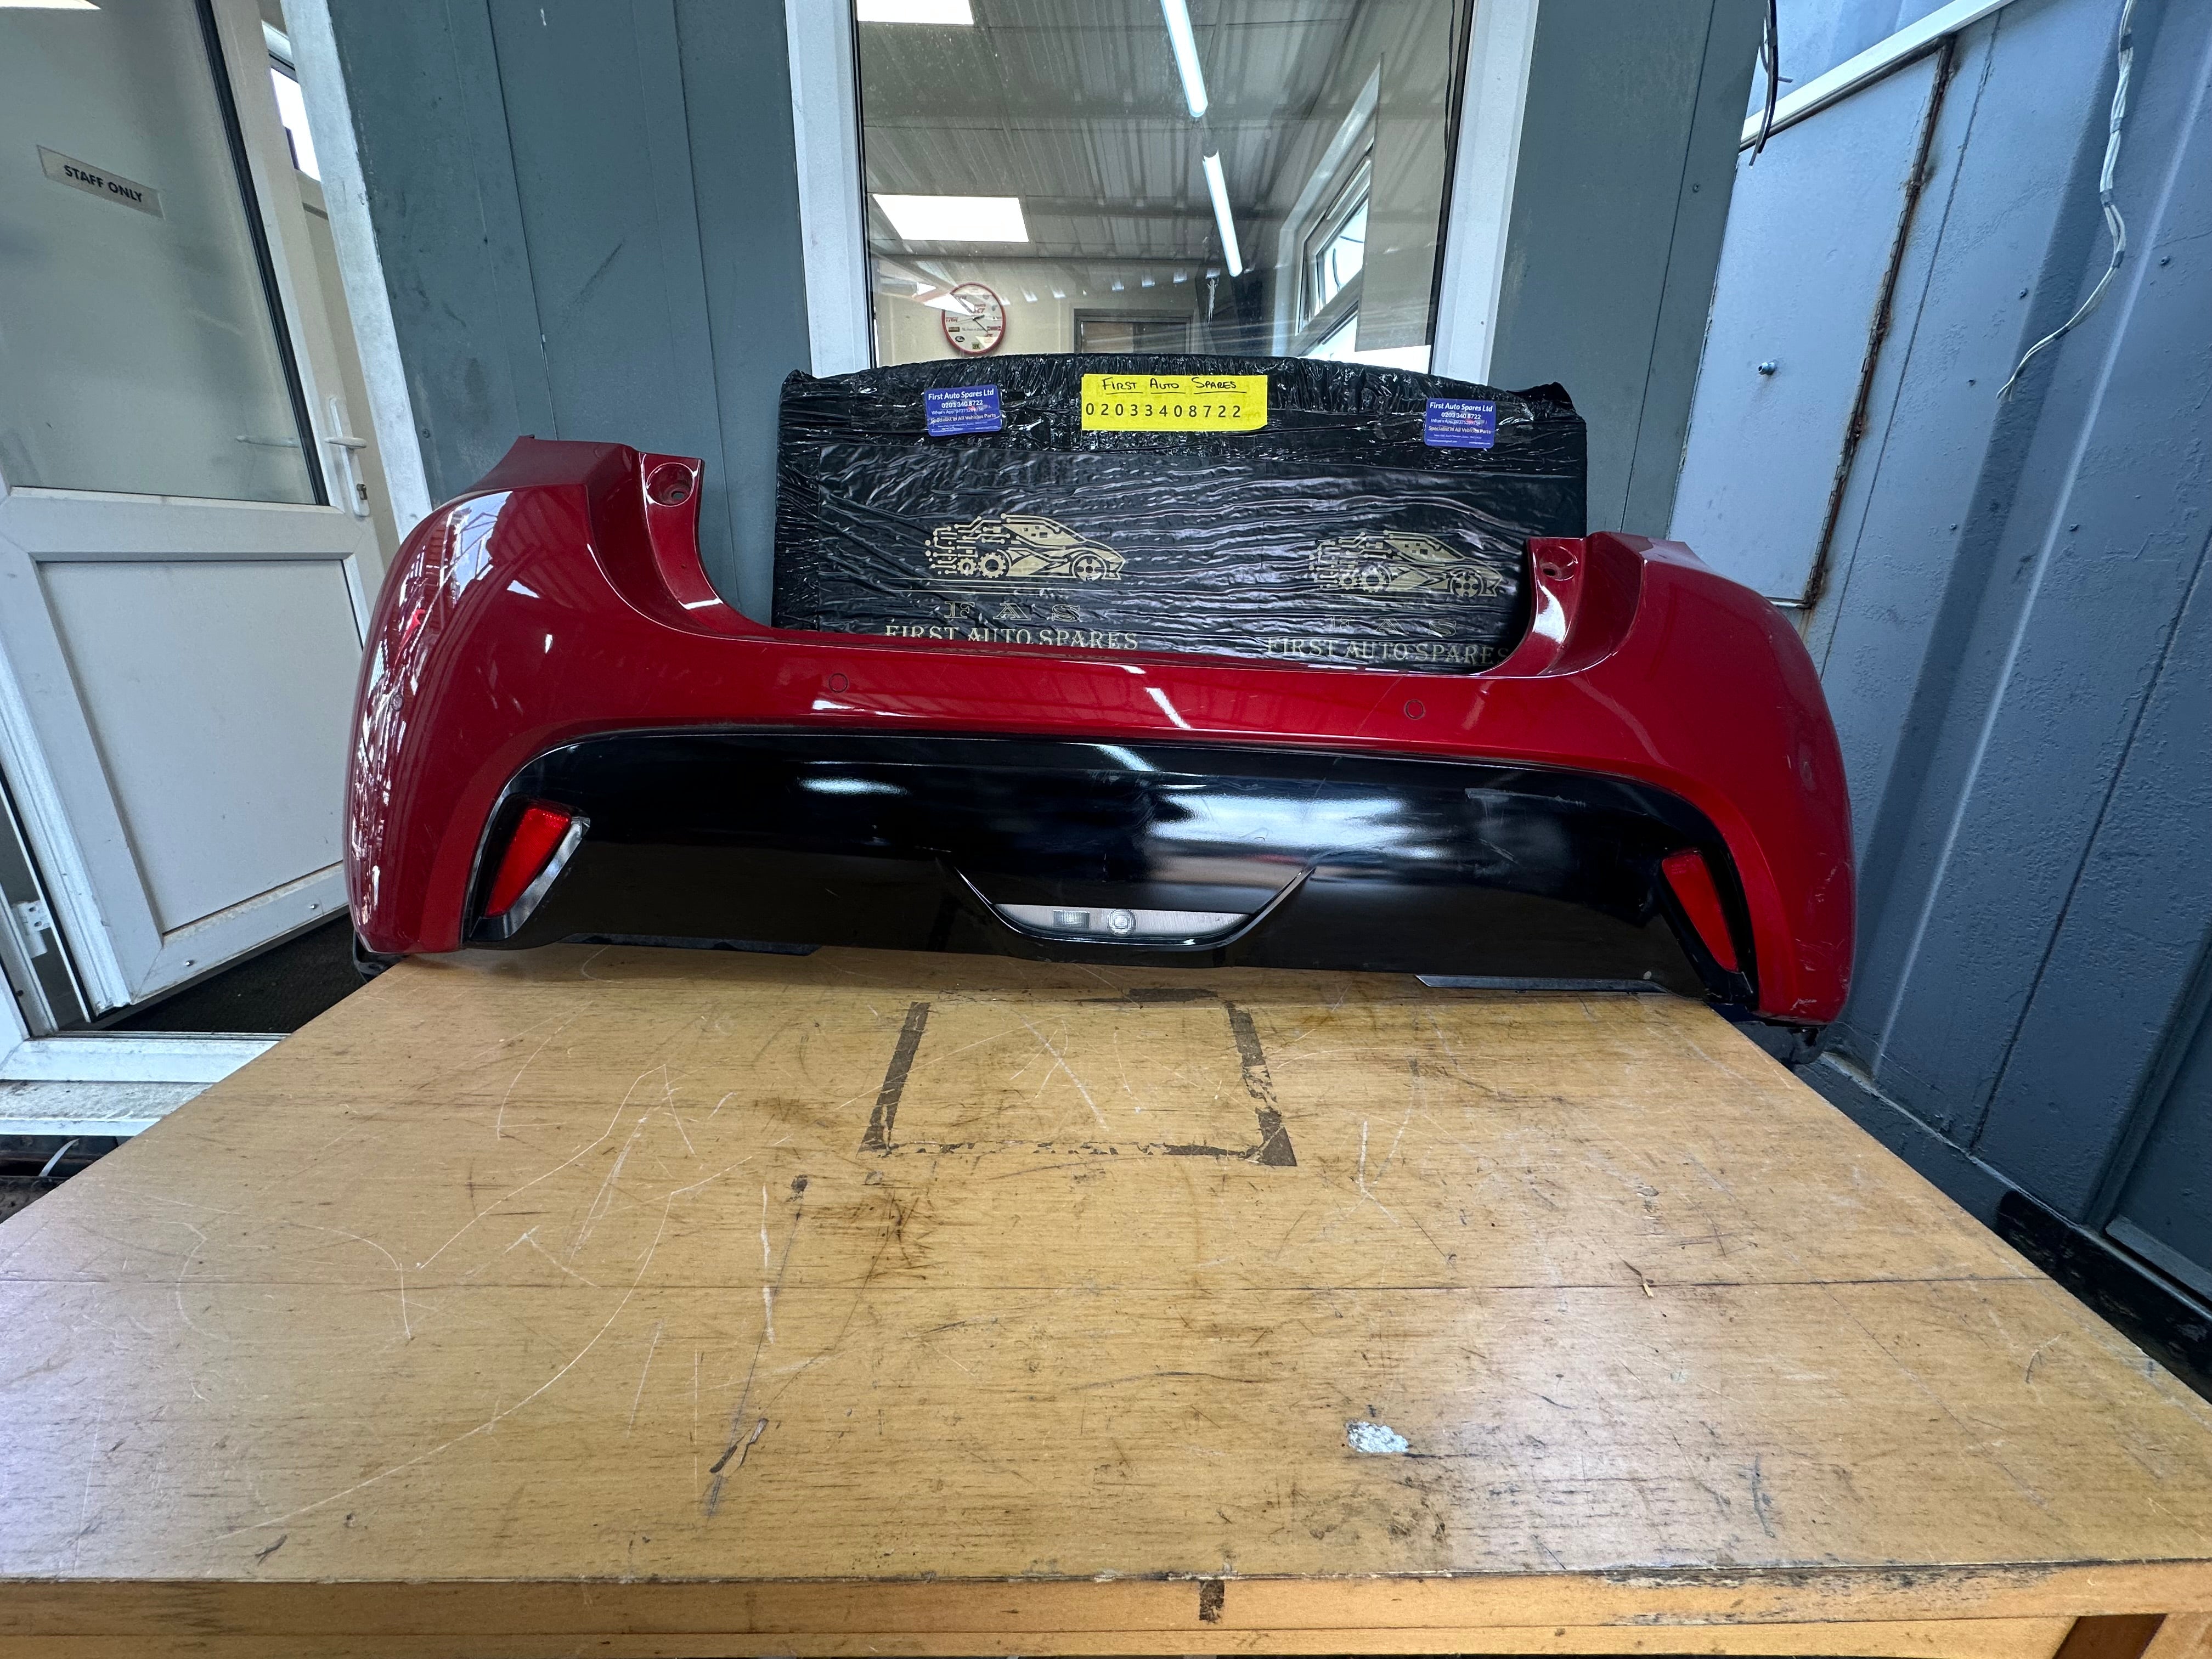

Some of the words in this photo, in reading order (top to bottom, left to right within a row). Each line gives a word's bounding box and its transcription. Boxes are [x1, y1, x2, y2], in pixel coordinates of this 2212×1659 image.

[64, 165, 104, 188] STAFF
[108, 182, 142, 202] ONLY
[1102, 377, 1137, 391] FIRST
[1149, 377, 1179, 389] AUTO
[1191, 377, 1237, 389] SPARES
[961, 390, 983, 399] Spares
[1461, 404, 1482, 412] Spares
[1039, 629, 1138, 650] SPARES
[1268, 637, 1338, 657] FIRST
[1346, 641, 1408, 659] AUTO
[1415, 643, 1509, 665] SPARES
